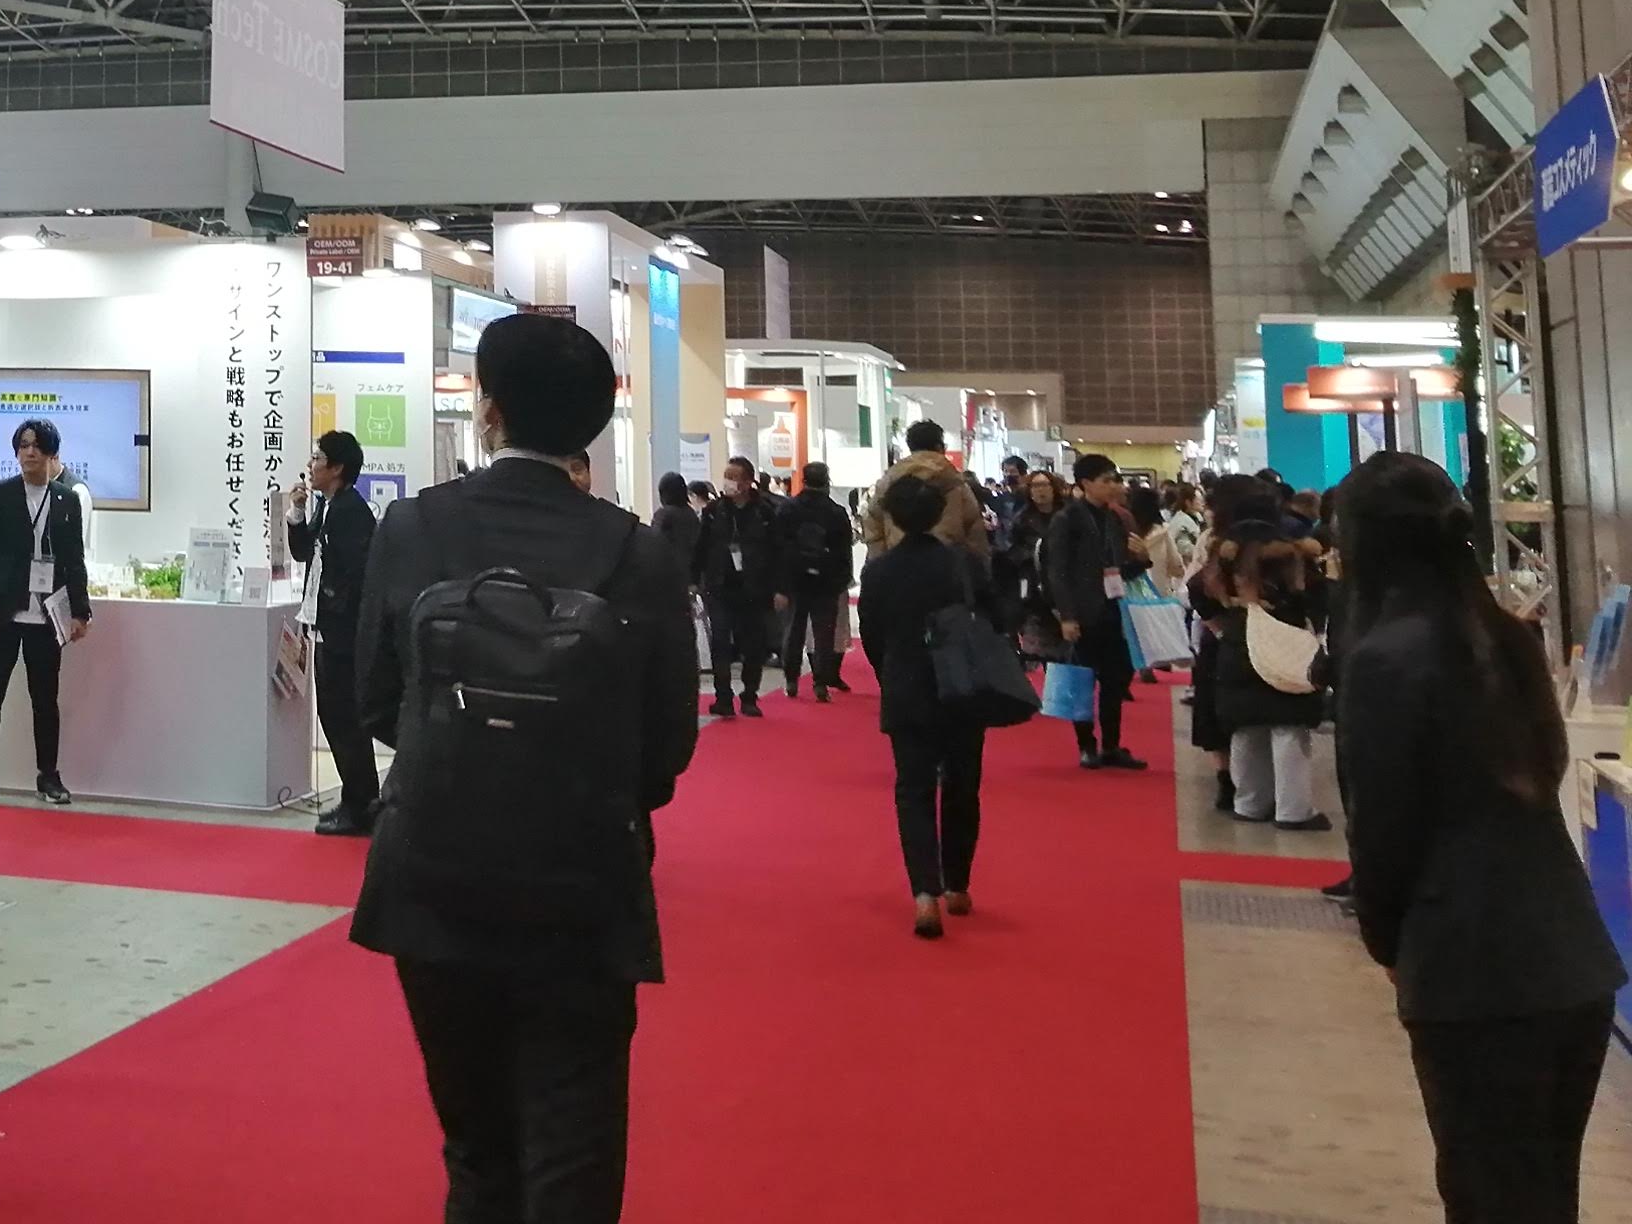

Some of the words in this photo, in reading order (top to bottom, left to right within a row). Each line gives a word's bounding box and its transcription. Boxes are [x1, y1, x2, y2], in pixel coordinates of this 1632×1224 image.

[313, 239, 356, 248] OEM/ODM
[316, 261, 353, 275] 19-41
[357, 383, 404, 393] フェムケア
